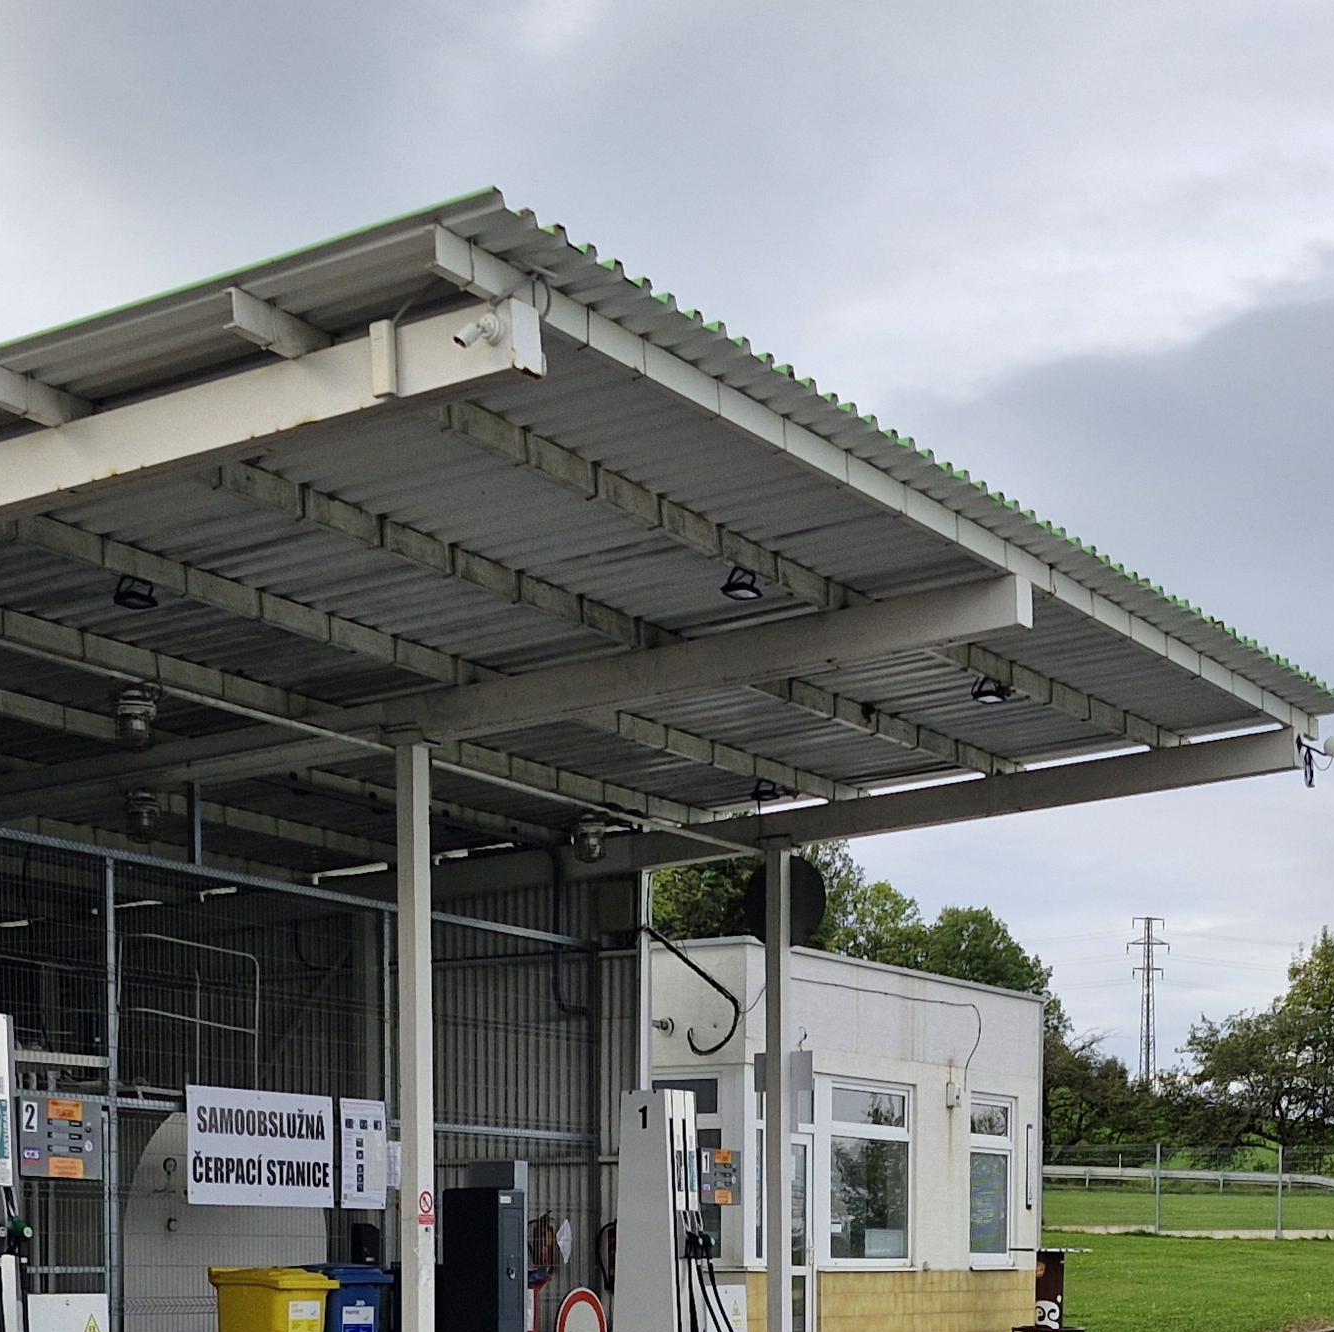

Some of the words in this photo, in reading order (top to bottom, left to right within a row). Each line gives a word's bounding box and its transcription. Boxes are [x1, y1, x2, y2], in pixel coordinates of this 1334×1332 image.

[25, 1103, 35, 1130] 2
[196, 1105, 326, 1141] SAMOOBSLUŽNÁ
[638, 1105, 648, 1129] 1
[192, 1150, 262, 1186] ČERPACÍ
[266, 1158, 330, 1188] STANICE
